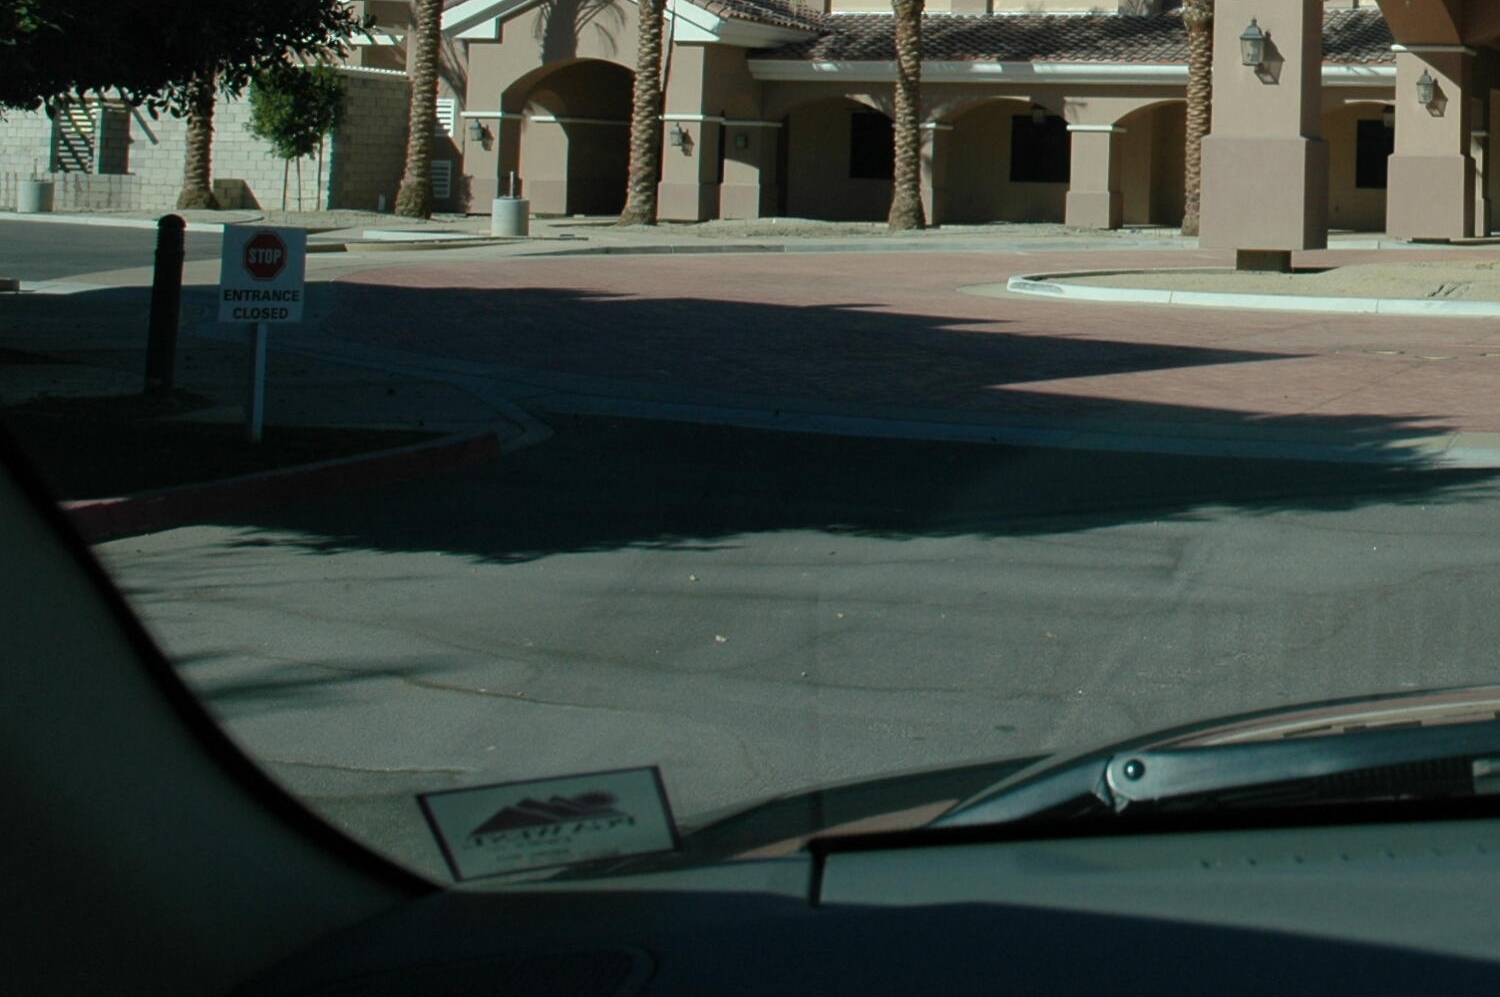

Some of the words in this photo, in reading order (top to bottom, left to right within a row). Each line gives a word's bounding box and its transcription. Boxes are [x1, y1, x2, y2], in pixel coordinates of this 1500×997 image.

[248, 248, 281, 264] STOP
[224, 289, 299, 301] ENTRANCE
[233, 307, 288, 320] CLOSED
